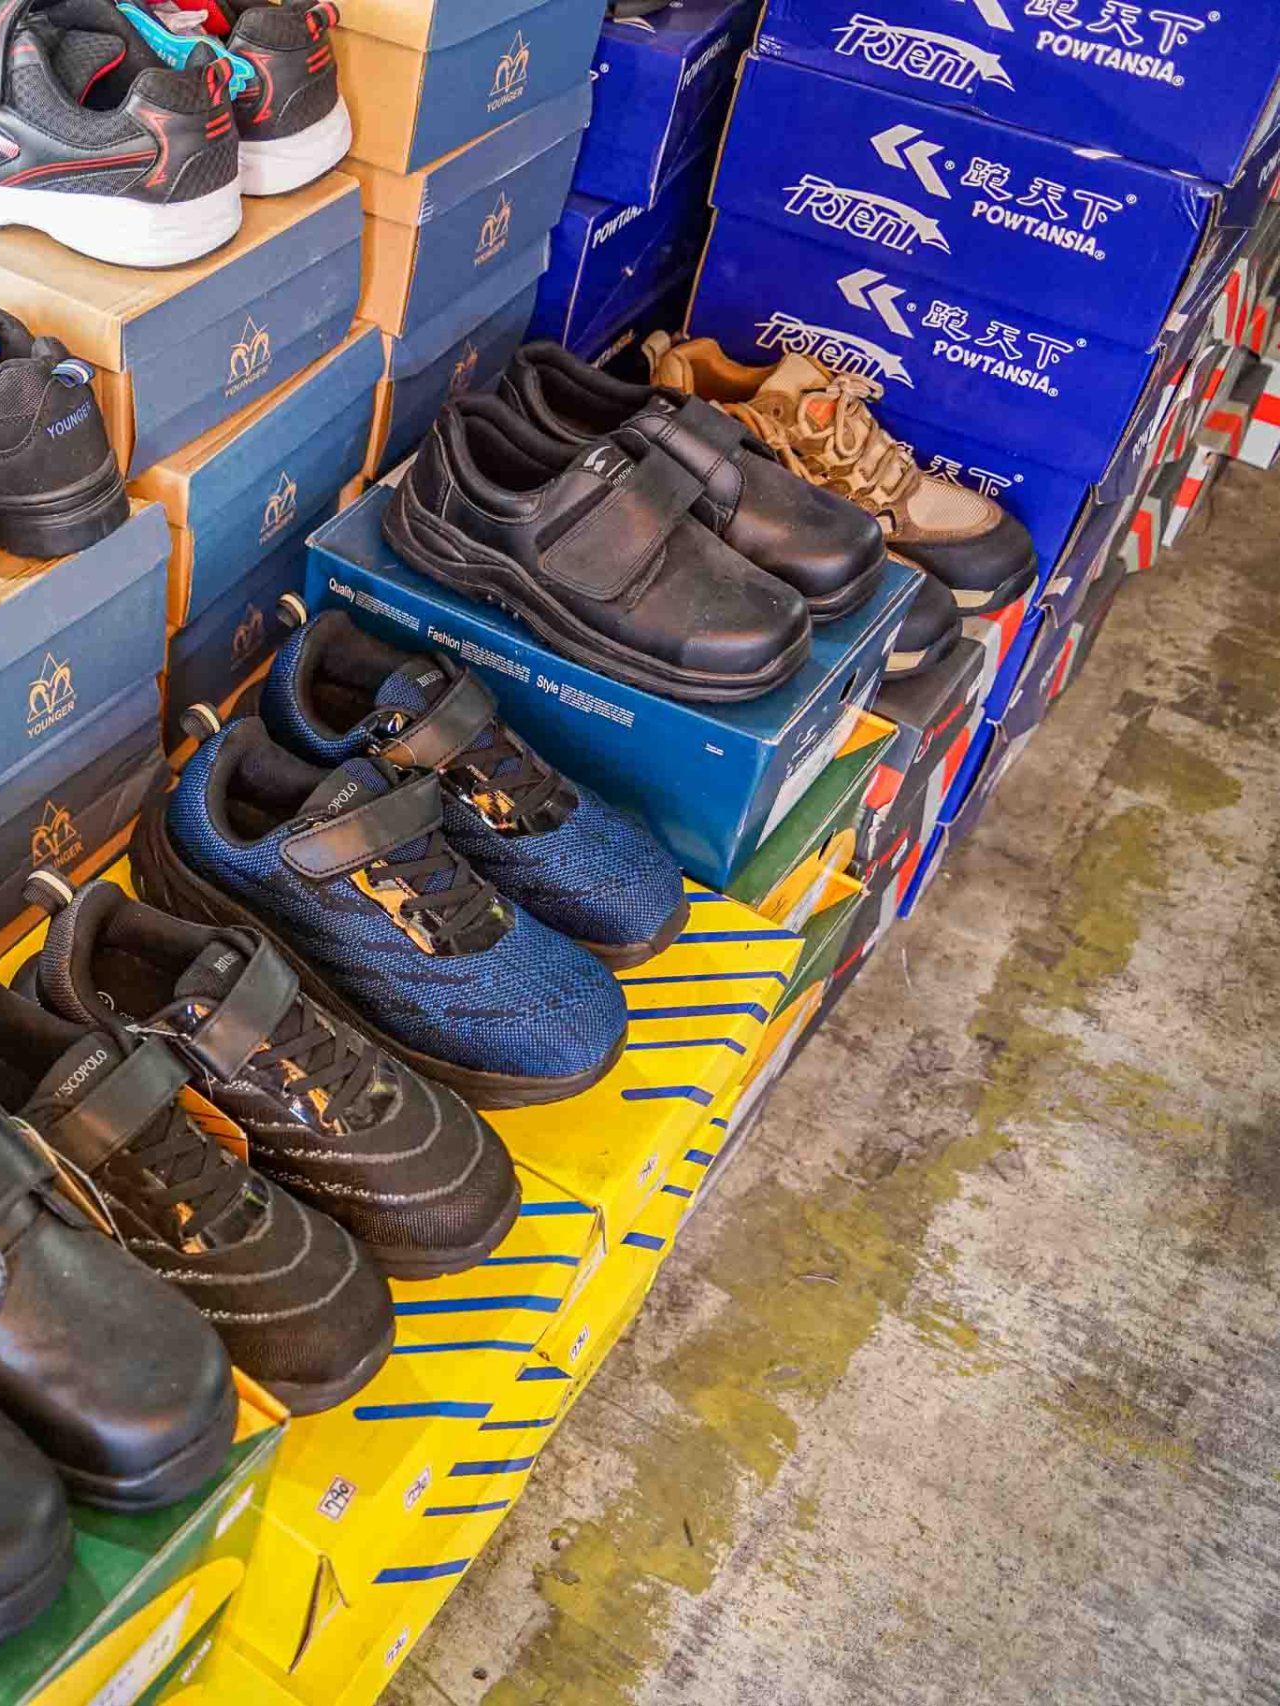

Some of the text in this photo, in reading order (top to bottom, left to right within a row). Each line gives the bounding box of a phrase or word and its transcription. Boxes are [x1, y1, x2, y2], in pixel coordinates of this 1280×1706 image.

[1036, 30, 1177, 84] POWTANSIA
[961, 156, 1123, 230] 跑天下
[972, 200, 1098, 257] POWTANSIA
[921, 300, 1075, 370] 跑天下
[932, 340, 1050, 395] POWTANSIA
[328, 577, 356, 603] Quality
[427, 626, 461, 651] Fashion
[536, 673, 559, 695] Style
[26, 700, 76, 739] YOUNGER
[54, 1049, 108, 1099] SCOPOLO
[324, 1483, 350, 1511] 790
